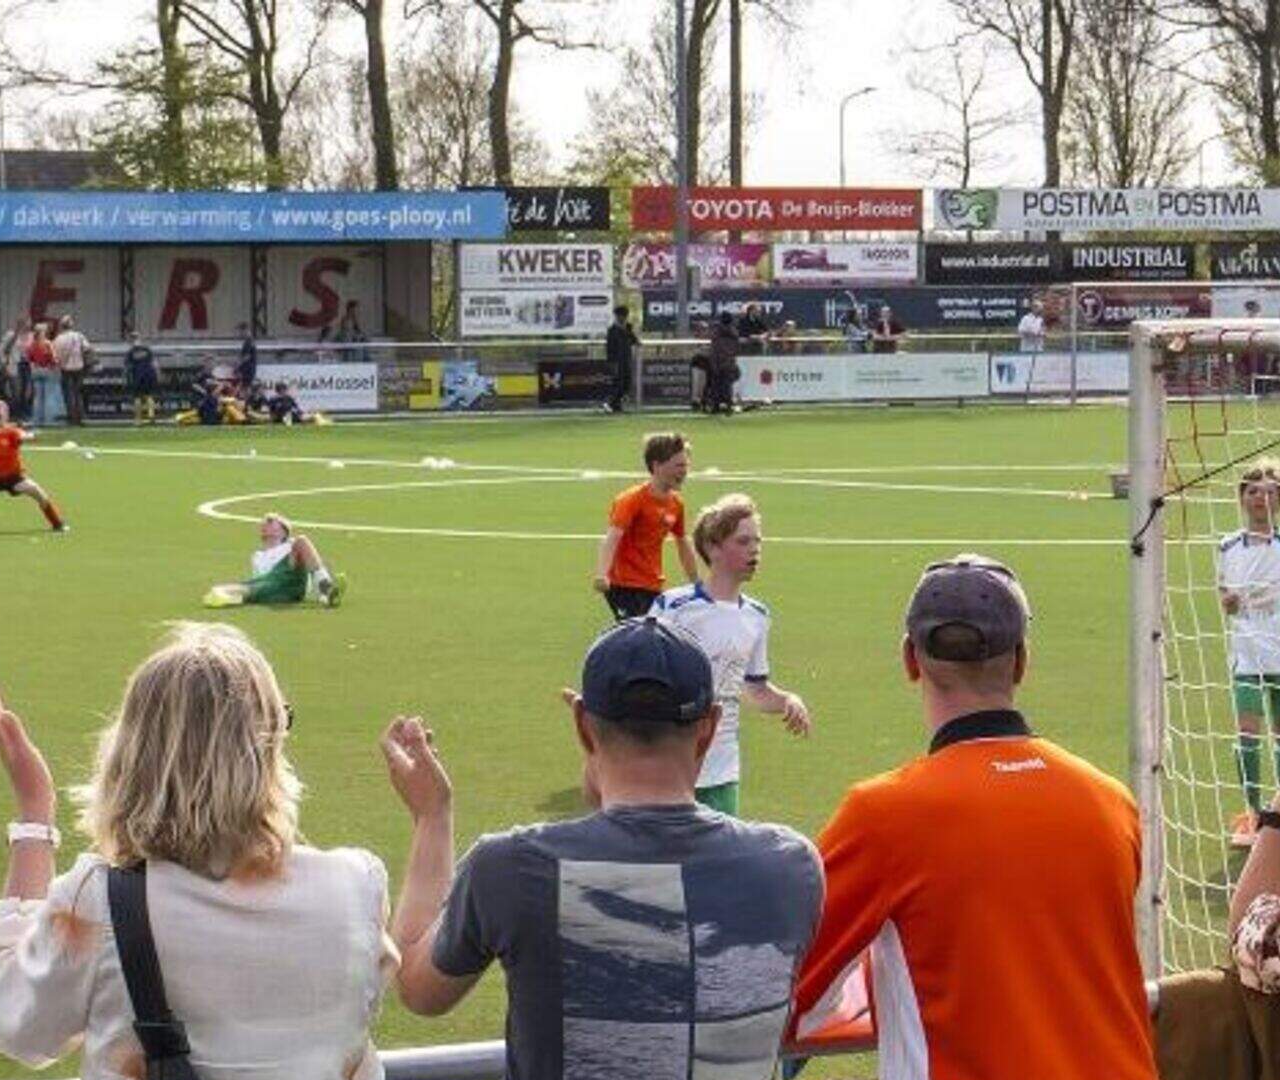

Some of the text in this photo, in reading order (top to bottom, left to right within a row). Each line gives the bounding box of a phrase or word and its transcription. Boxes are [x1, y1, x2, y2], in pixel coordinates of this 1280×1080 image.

[781, 200, 802, 215] De
[1023, 191, 1129, 217] POSTMA
[1158, 191, 1261, 216] POSTMA
[13, 204, 105, 226] dakwerk
[127, 206, 252, 231] verwarming
[272, 204, 471, 231] www.goes-plooy.nl
[498, 249, 603, 273] KWEKER
[1072, 246, 1186, 267] INDUSTRIAL
